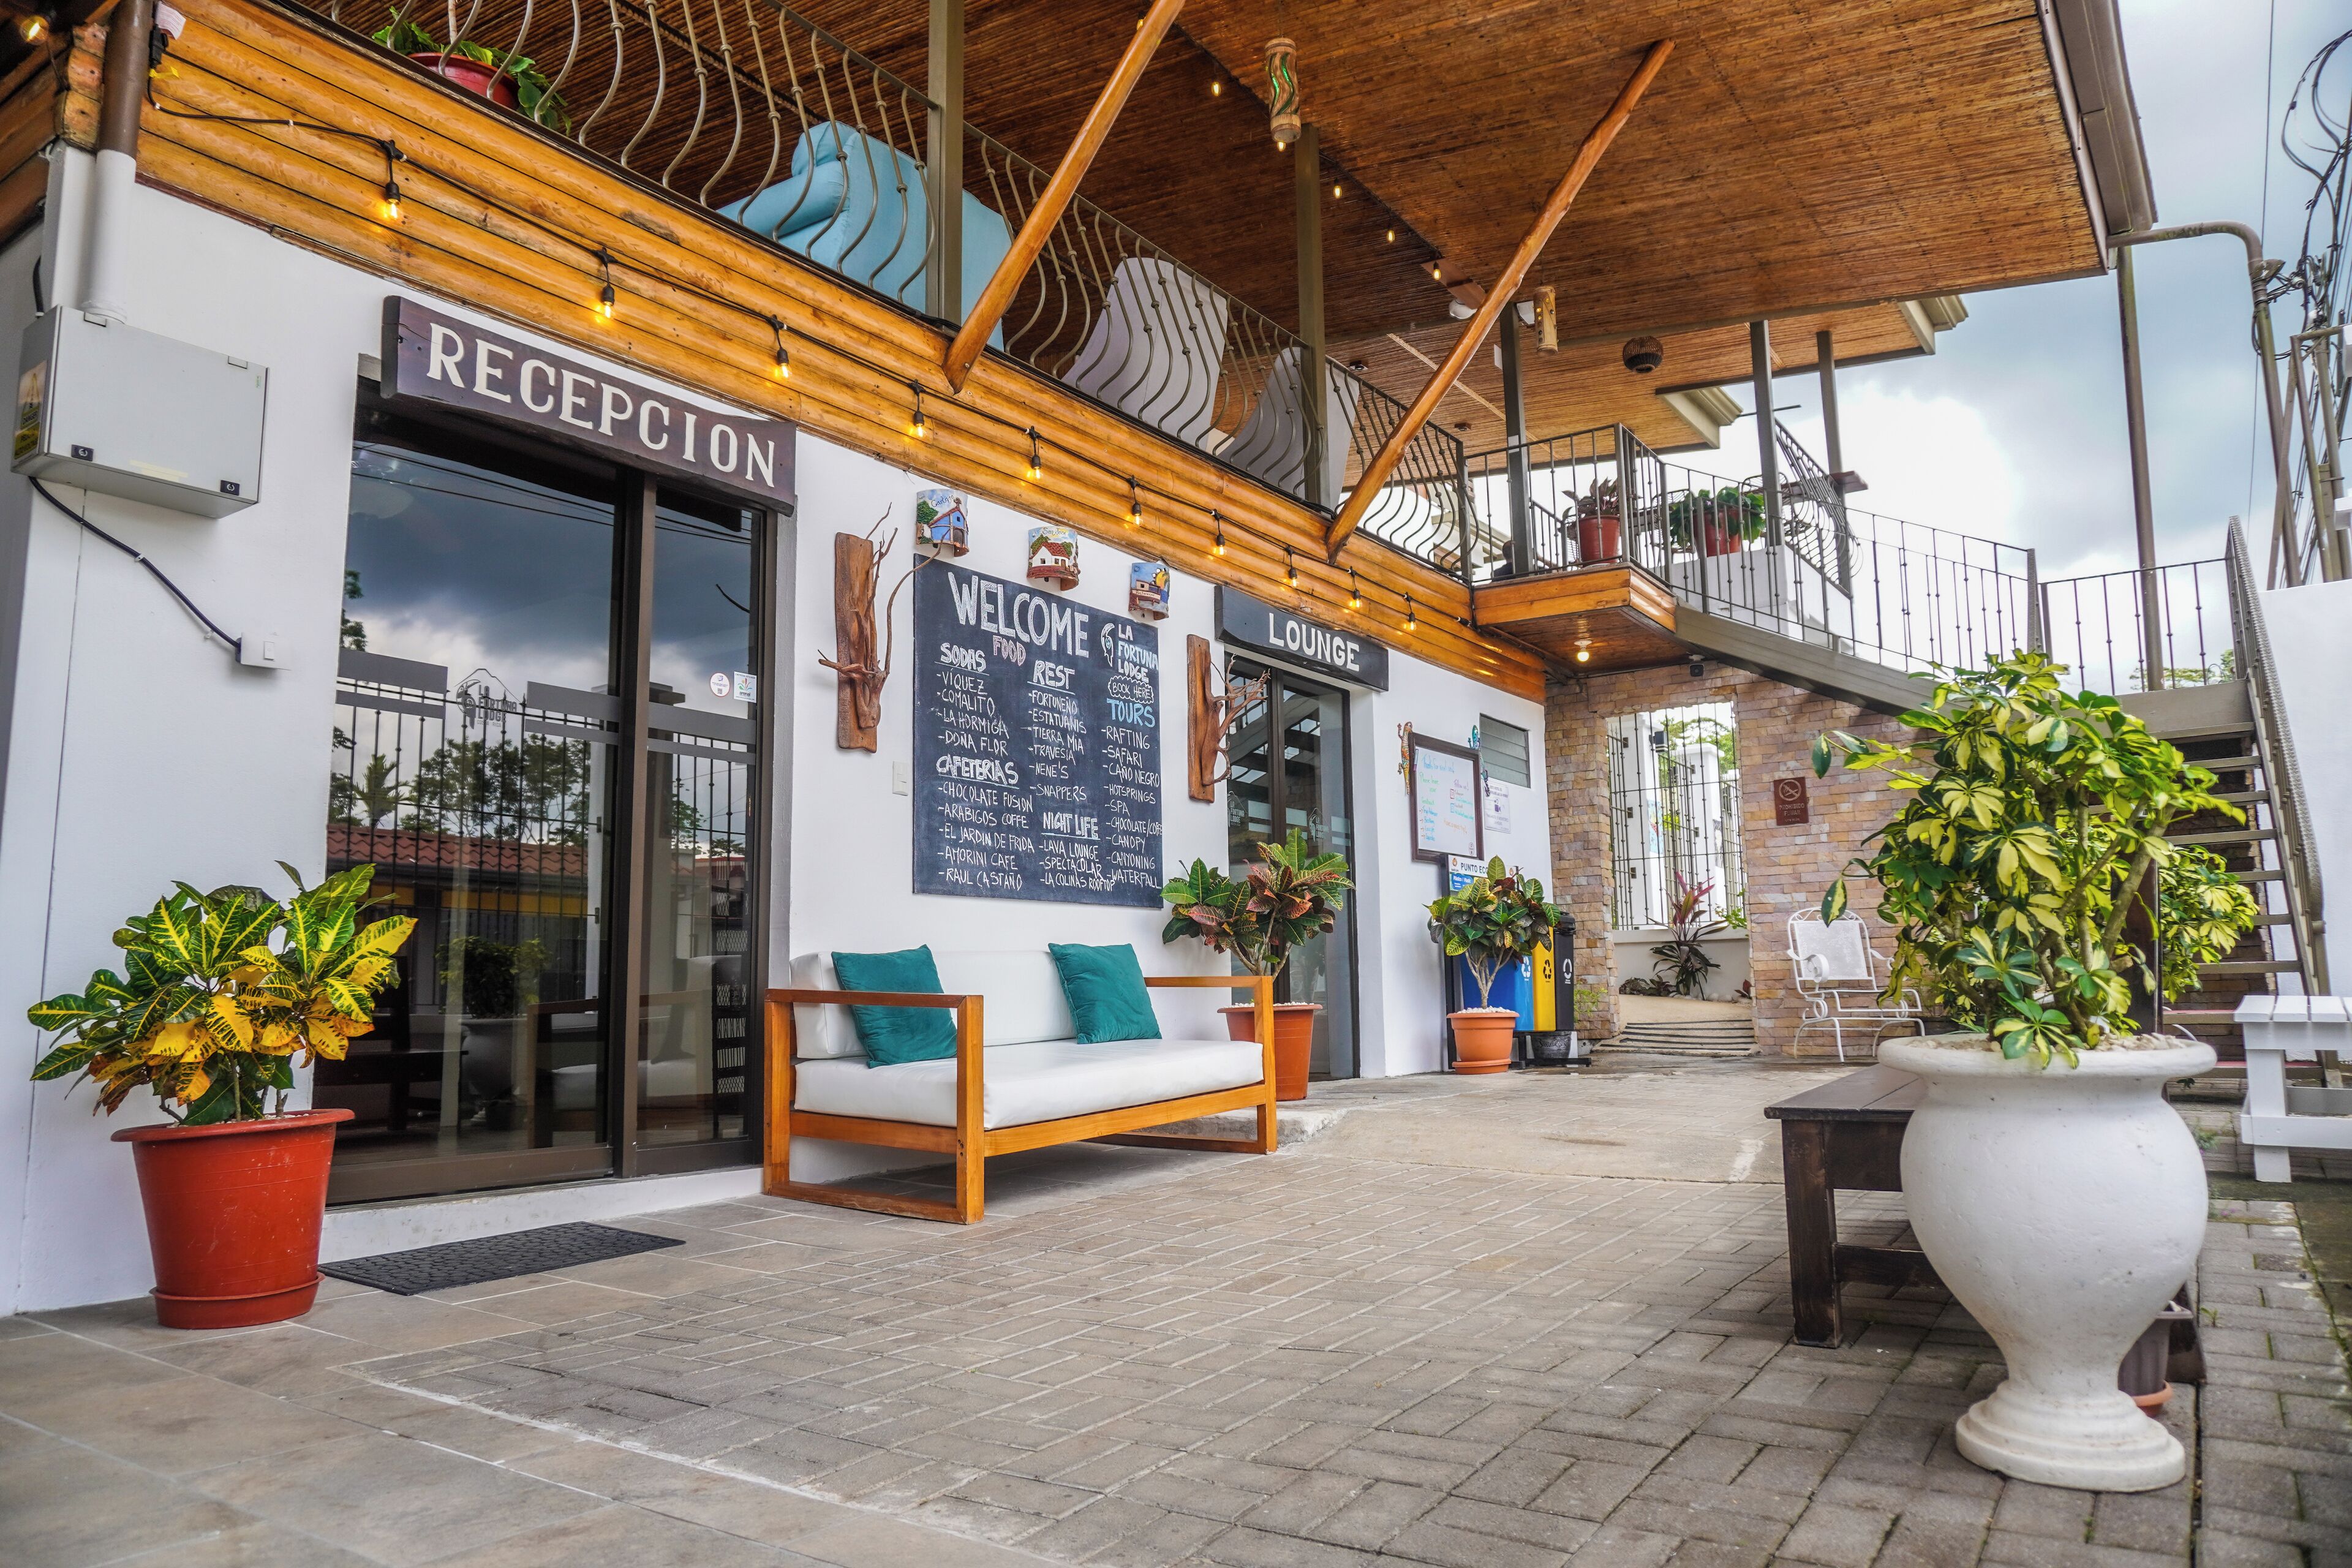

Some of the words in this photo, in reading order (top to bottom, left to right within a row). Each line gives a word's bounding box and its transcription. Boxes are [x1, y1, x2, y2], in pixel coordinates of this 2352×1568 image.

[426, 322, 775, 488] RECEPCION
[931, 495, 954, 507] Cartago
[948, 571, 1089, 658] WELCOME
[1118, 624, 1133, 641] LA
[1269, 612, 1360, 671] LOUNGE
[940, 643, 987, 673] SODAS
[992, 635, 1027, 666] FOOD
[1118, 640, 1159, 670] FORTUNA
[1033, 660, 1076, 690] REST
[1118, 658, 1149, 684] LODGE
[479, 684, 489, 697] LA
[1112, 682, 1130, 695] BOOK
[1134, 685, 1152, 699] HERE
[478, 696, 518, 712] FORTUNA
[1107, 698, 1156, 728] TOURS
[478, 709, 507, 723] LODGE
[958, 711, 1009, 739] HORMIGA
[980, 737, 1008, 758] FLOR
[1135, 769, 1160, 788] NEGRO
[1003, 791, 1033, 813] FUSION
[1001, 813, 1029, 829] COFFE
[1230, 808, 1245, 818] FORTUNA
[1043, 812, 1072, 833] NIGHT
[1074, 814, 1099, 839] LIFE
[959, 826, 992, 846] JARDIN
[994, 832, 1006, 849] DE
[1009, 834, 1035, 853] FRIDA
[990, 853, 1019, 870] CAFE
[1069, 842, 1099, 862] LOUNGE
[1461, 862, 1478, 873] PUNTO
[1089, 877, 1115, 892] ROOFTOP
